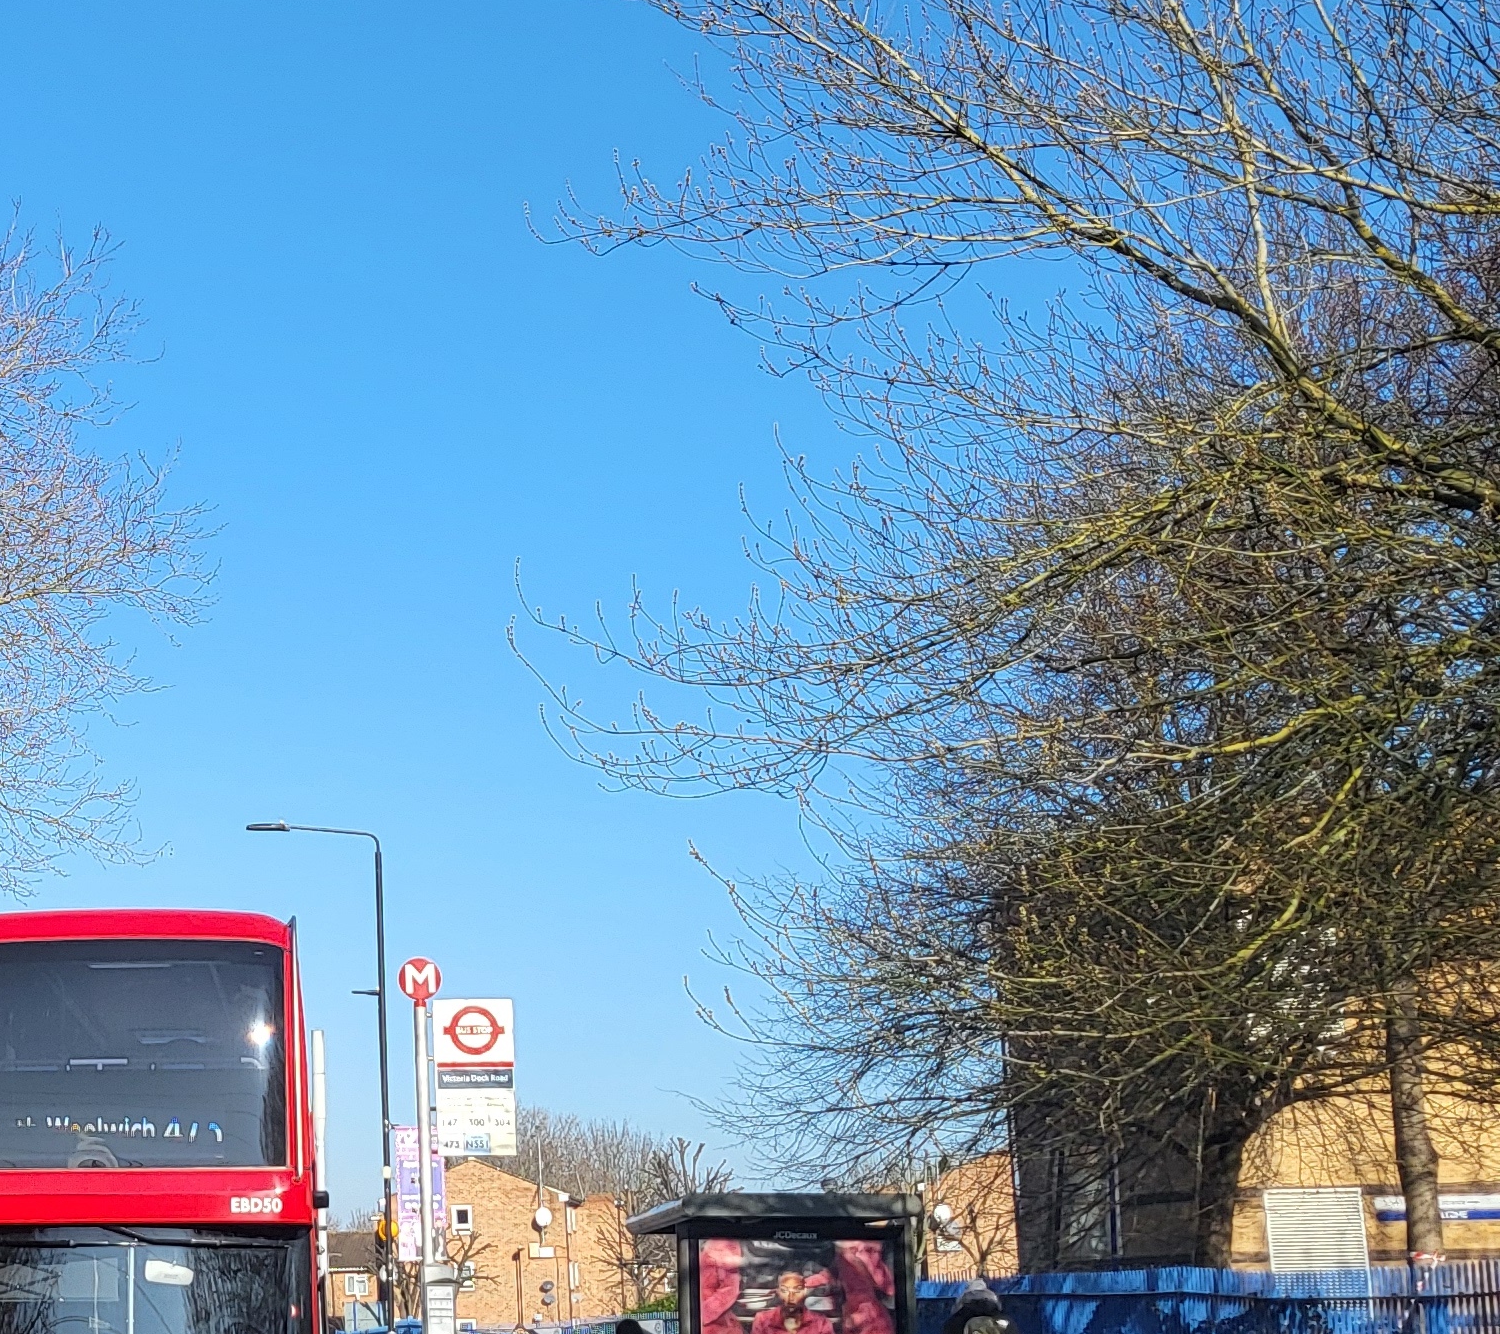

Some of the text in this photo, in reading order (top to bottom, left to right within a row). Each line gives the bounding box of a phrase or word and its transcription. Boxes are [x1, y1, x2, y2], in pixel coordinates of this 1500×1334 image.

[404, 963, 437, 995] M
[455, 1026, 494, 1034] BUS STOP
[490, 1074, 508, 1082] Road
[466, 1140, 489, 1149] N551
[230, 1197, 283, 1214] EBD50
[773, 1231, 818, 1240] JCDecaux
